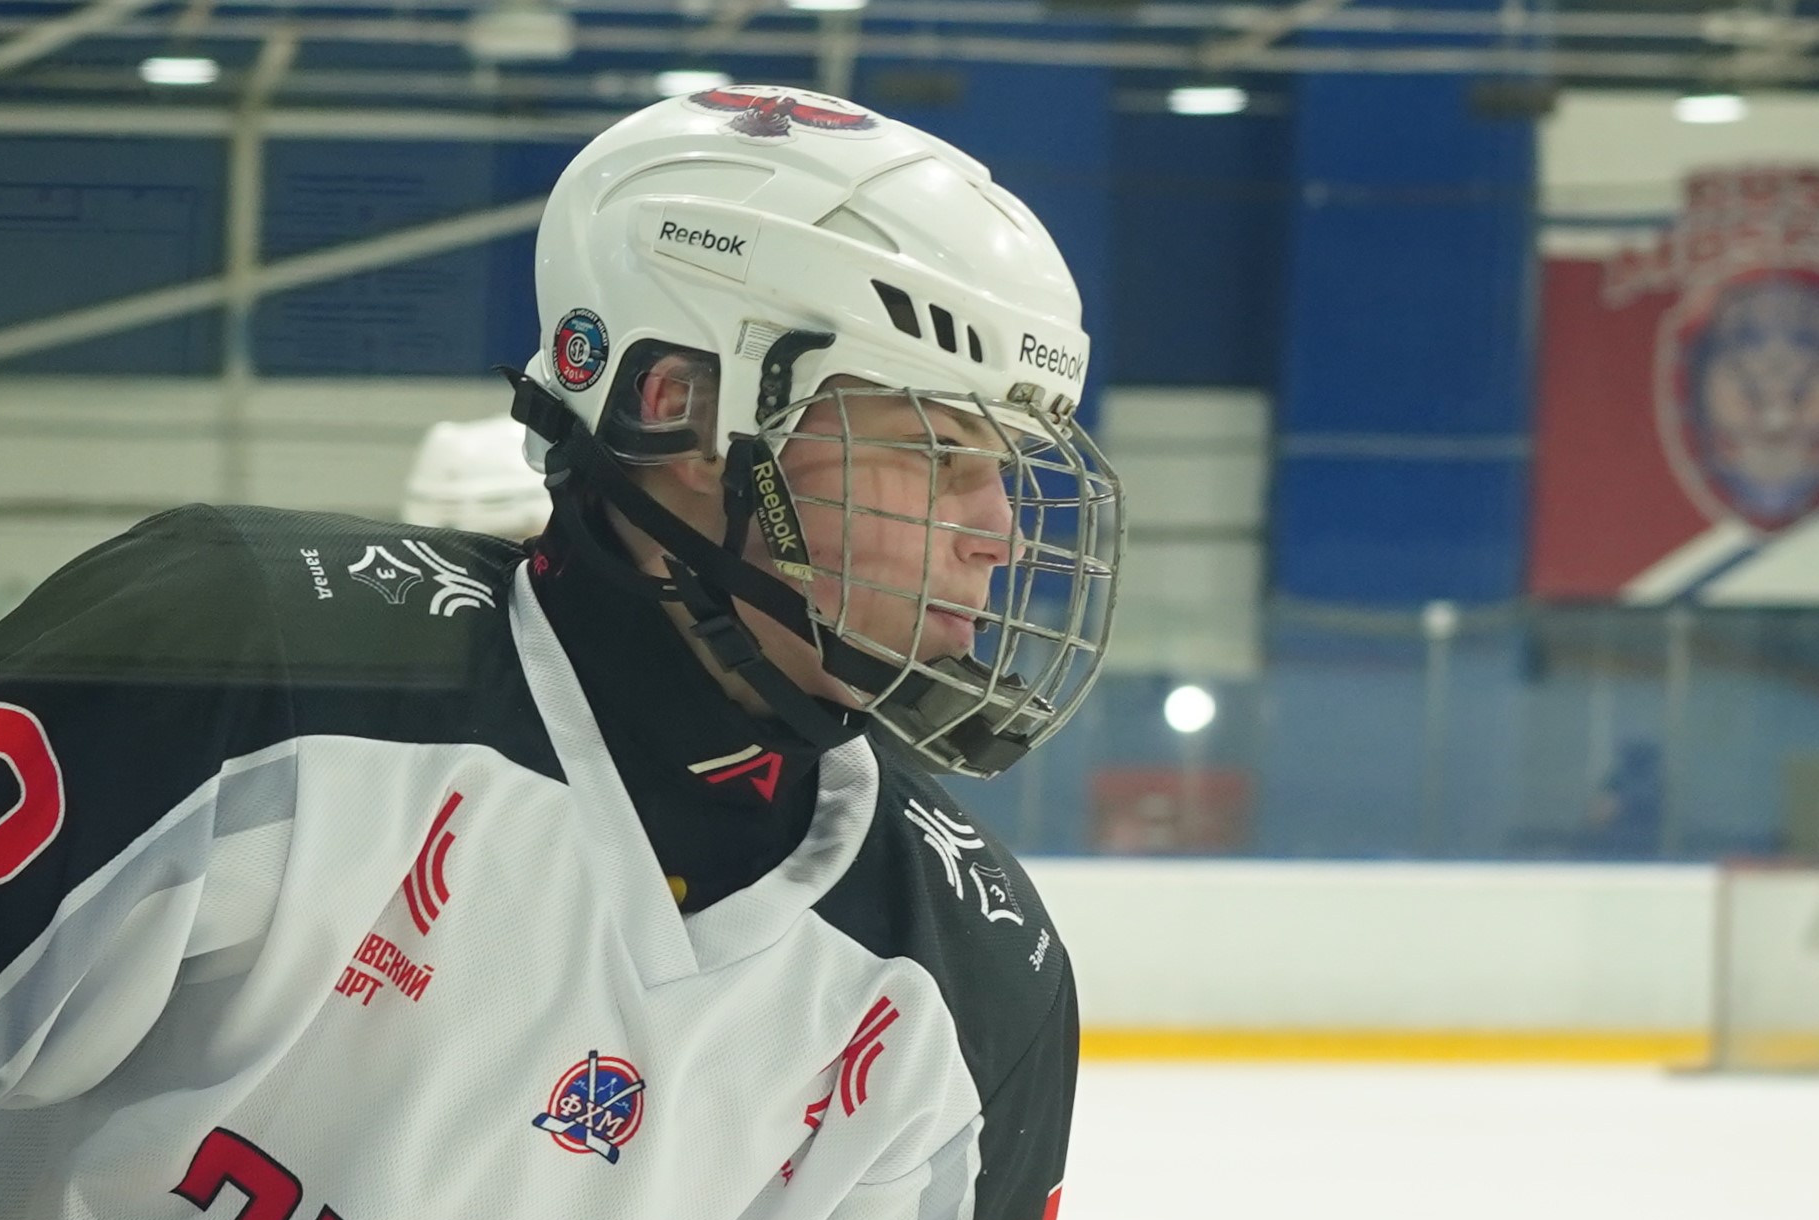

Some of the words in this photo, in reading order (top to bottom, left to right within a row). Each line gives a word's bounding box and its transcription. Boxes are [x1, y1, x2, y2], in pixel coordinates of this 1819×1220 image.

[659, 221, 747, 256] Reebok
[1019, 332, 1084, 384] Reebok
[753, 460, 797, 553] Reebok
[353, 931, 435, 1003] ВСКИЙ
[560, 1093, 625, 1137] ФХМ
